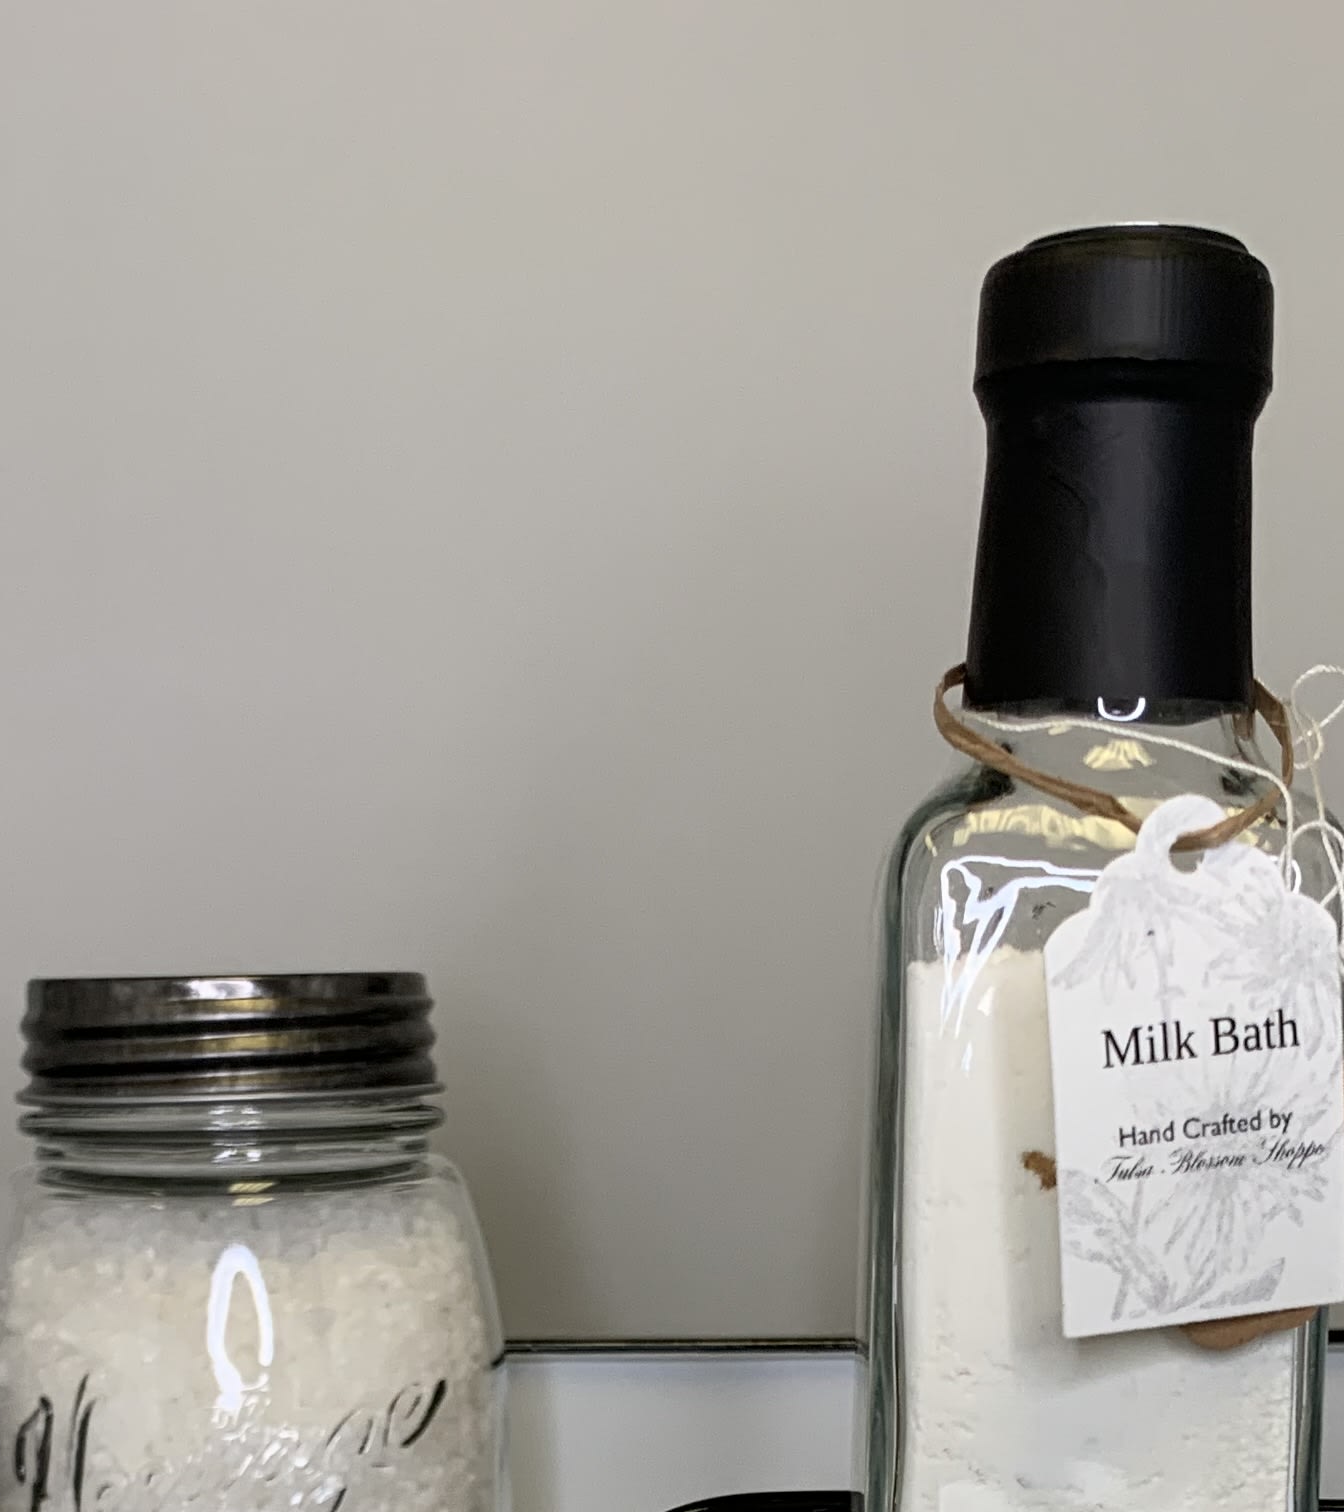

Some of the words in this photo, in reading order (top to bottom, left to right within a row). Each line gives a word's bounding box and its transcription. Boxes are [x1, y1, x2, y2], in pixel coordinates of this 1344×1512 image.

[1101, 1021, 1197, 1069] Milk
[1210, 1009, 1300, 1056] Bath
[1119, 1121, 1175, 1147] Hand
[1183, 1110, 1261, 1139] Crafted
[1269, 1109, 1293, 1134] by
[1168, 1148, 1245, 1176] Blossom
